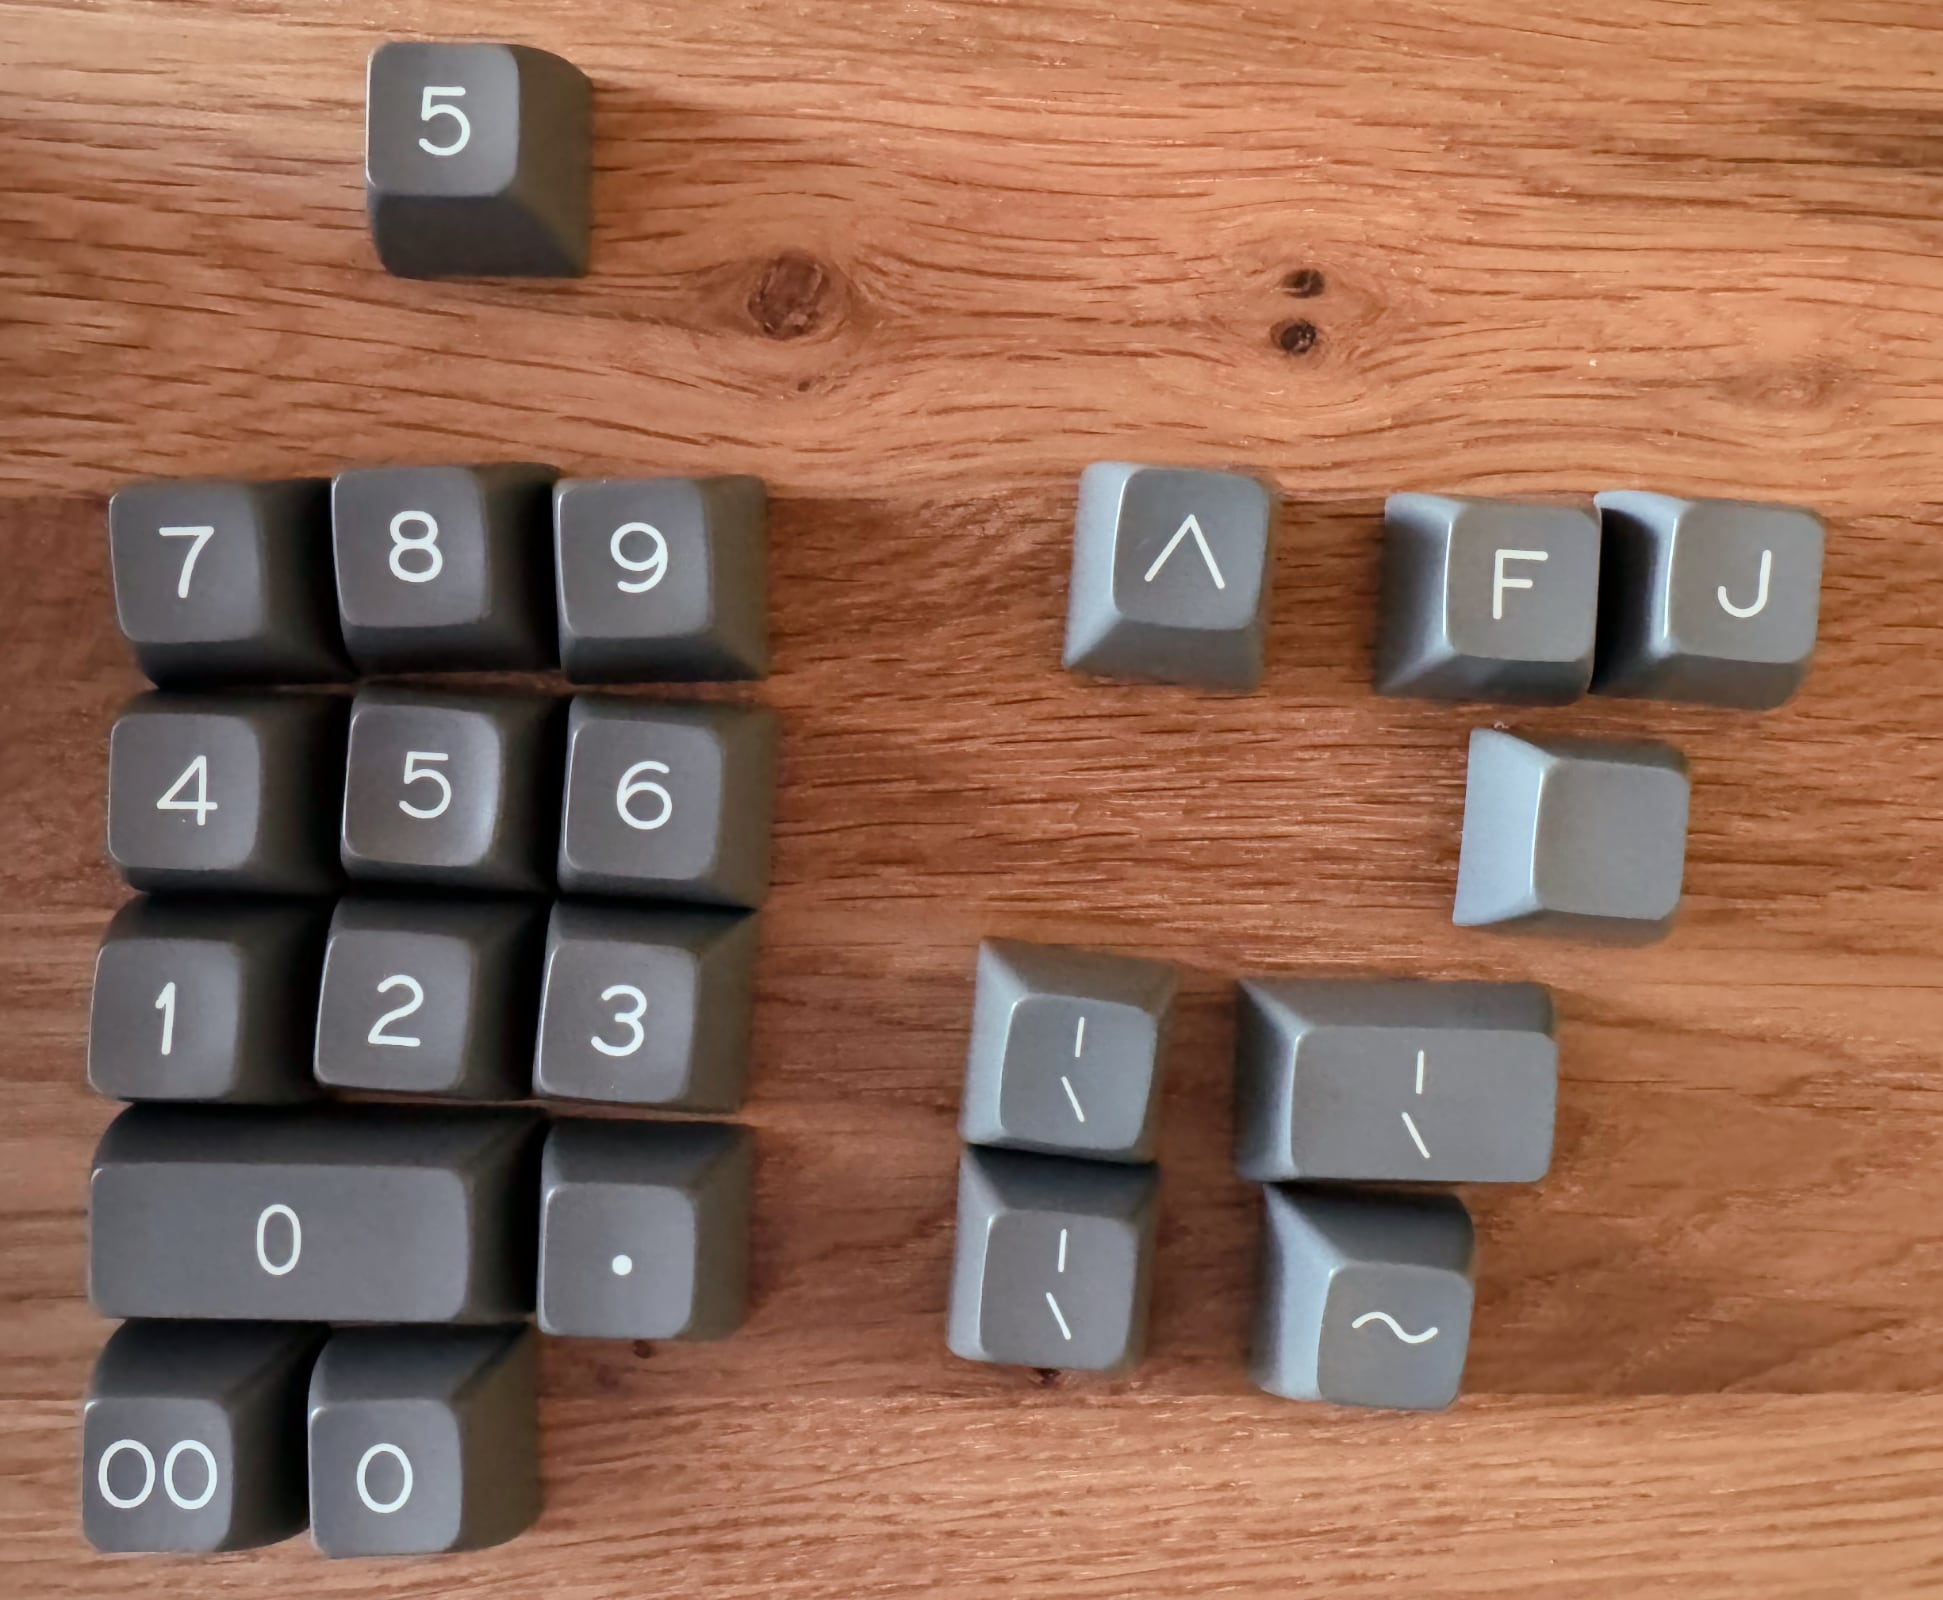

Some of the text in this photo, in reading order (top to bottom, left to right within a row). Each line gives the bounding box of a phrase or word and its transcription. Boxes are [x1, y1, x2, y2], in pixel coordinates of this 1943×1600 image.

[418, 86, 471, 156] 5
[158, 525, 215, 599] 7
[388, 510, 443, 583] 8
[610, 522, 669, 594] 9
[1492, 548, 1549, 620] F
[1717, 549, 1772, 618] J
[156, 755, 218, 826] 4
[399, 751, 452, 819] 5
[616, 760, 673, 830] 6
[155, 981, 176, 1056] 1
[367, 974, 424, 1047] 2
[590, 984, 648, 1057] 3
[256, 1203, 302, 1276] 0
